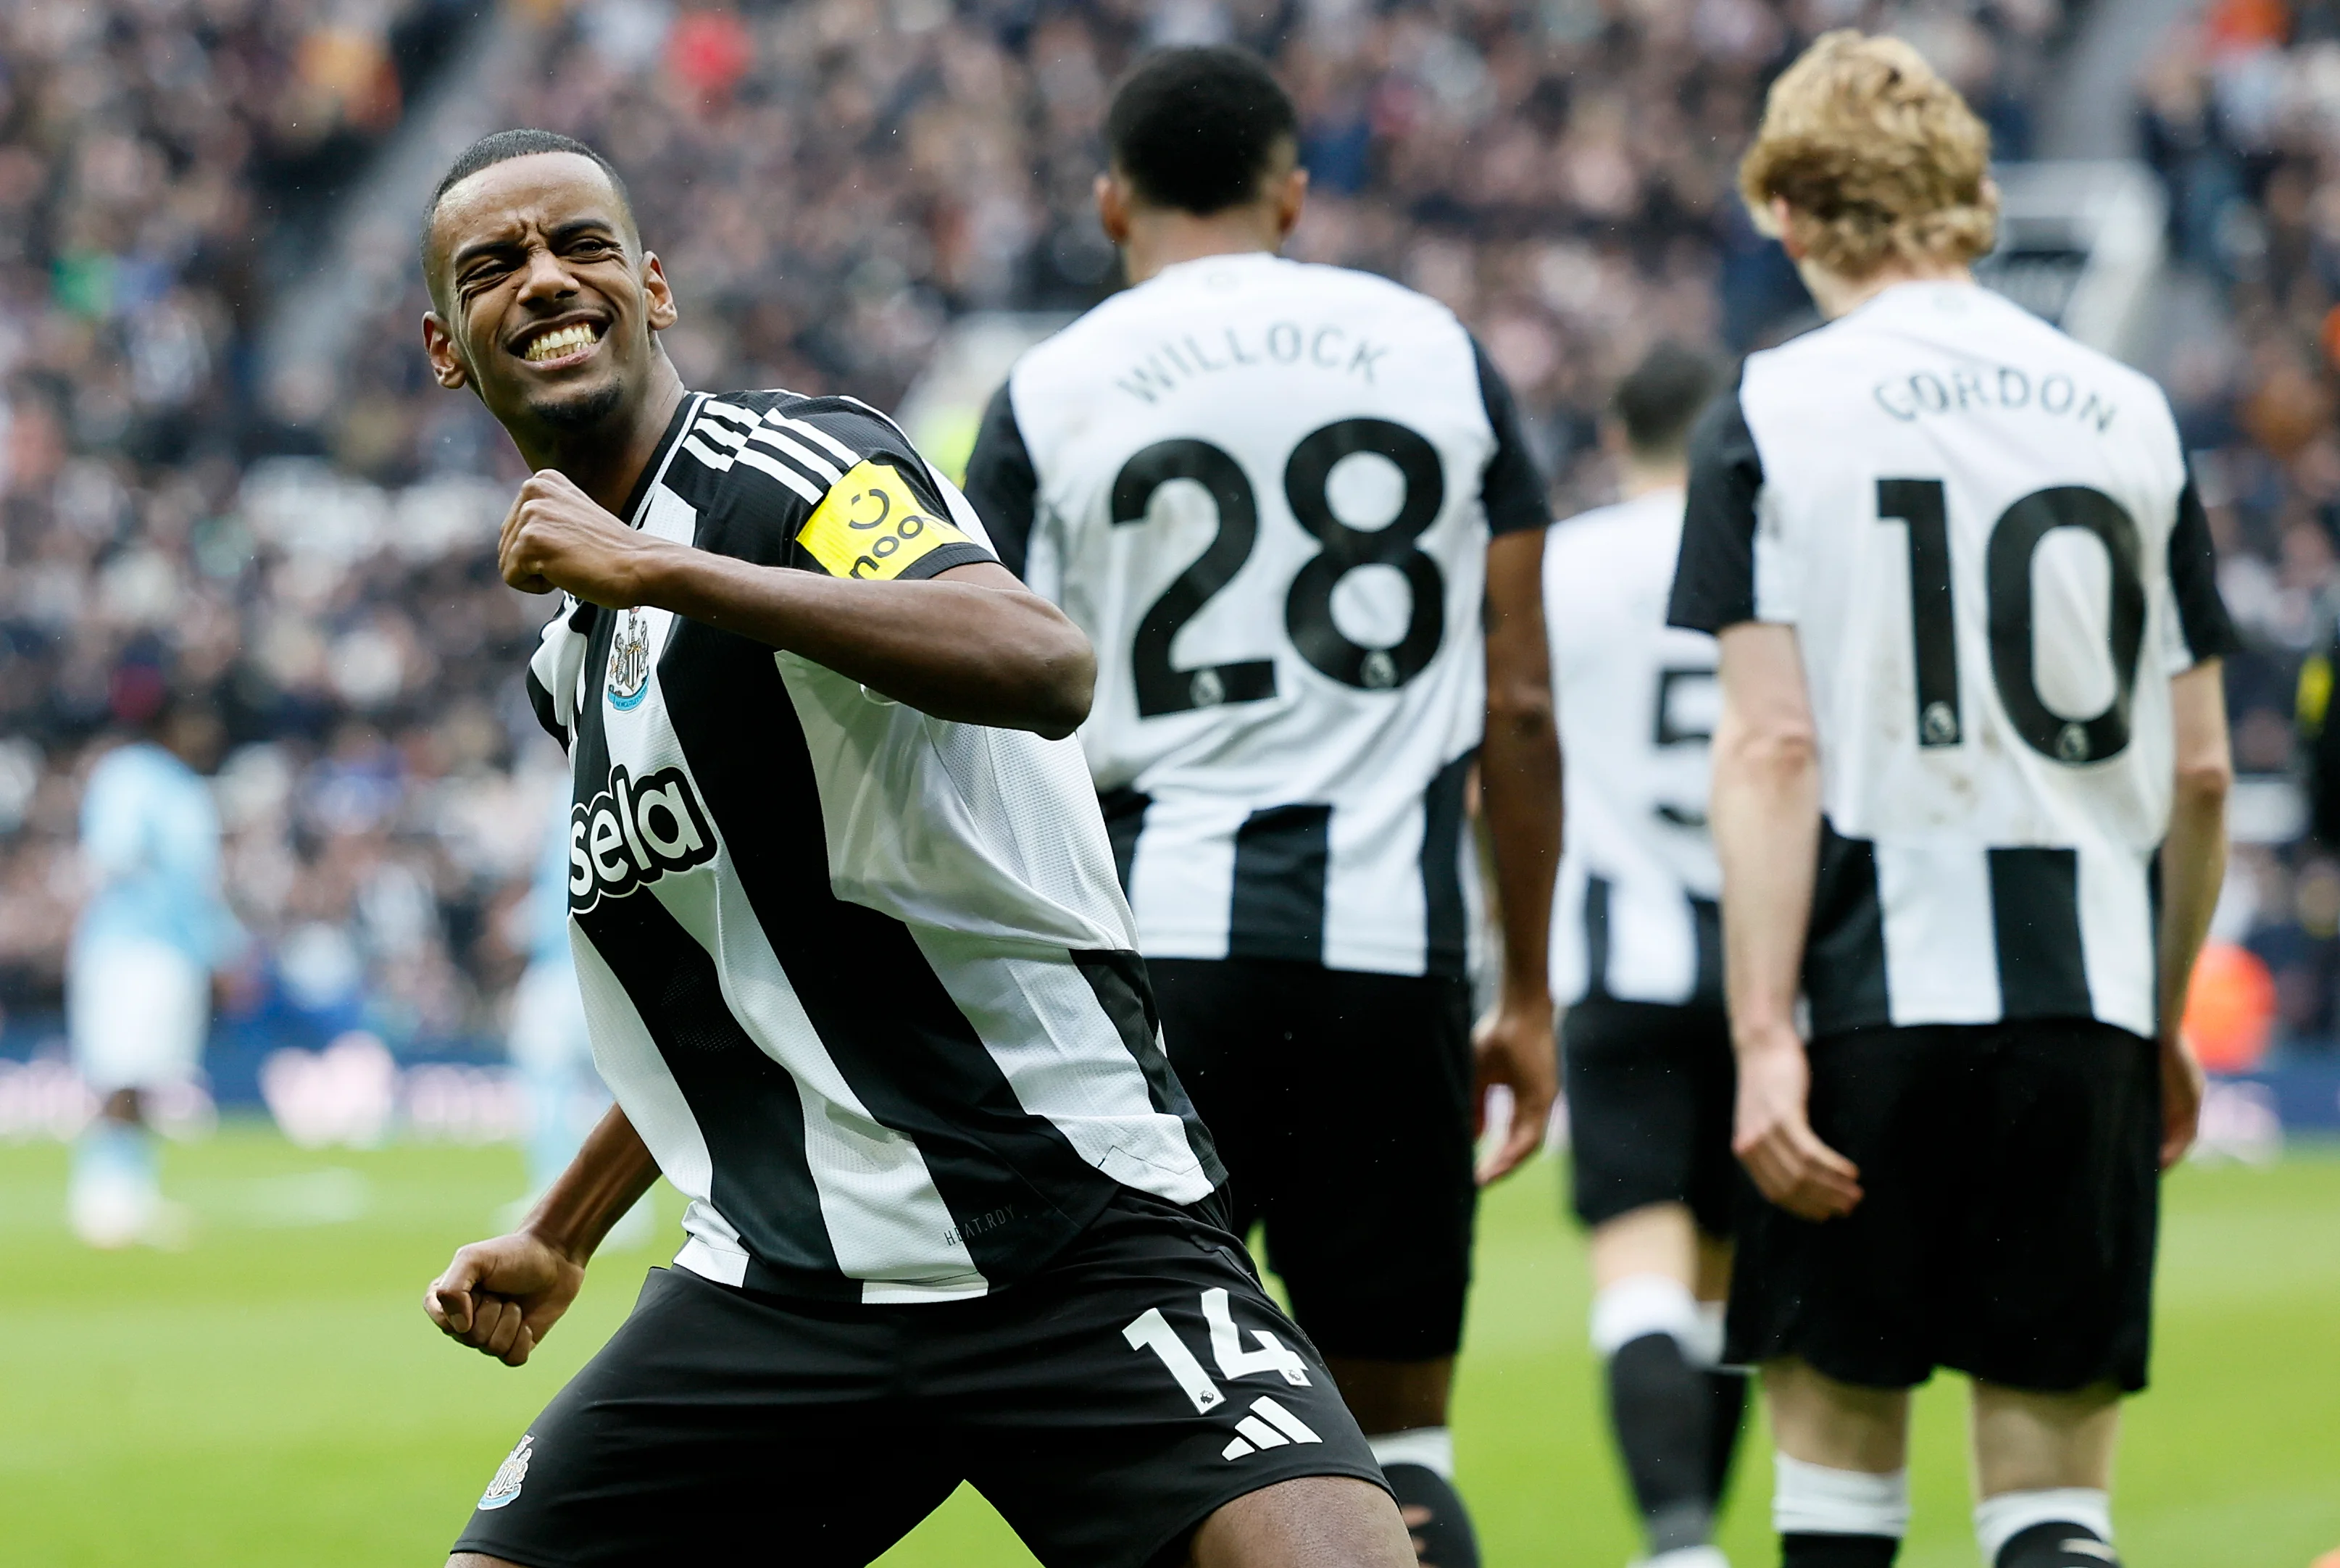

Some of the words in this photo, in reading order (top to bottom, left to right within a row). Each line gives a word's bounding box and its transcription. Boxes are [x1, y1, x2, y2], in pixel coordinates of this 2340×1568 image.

[1115, 322, 1391, 405] WILLOCK
[849, 514, 929, 579] noo
[1109, 417, 1446, 720] 28
[1876, 476, 2148, 763] 10
[570, 777, 704, 897] sela
[944, 1204, 1015, 1246] HEAT.RDY
[1121, 1287, 1313, 1416] 14
